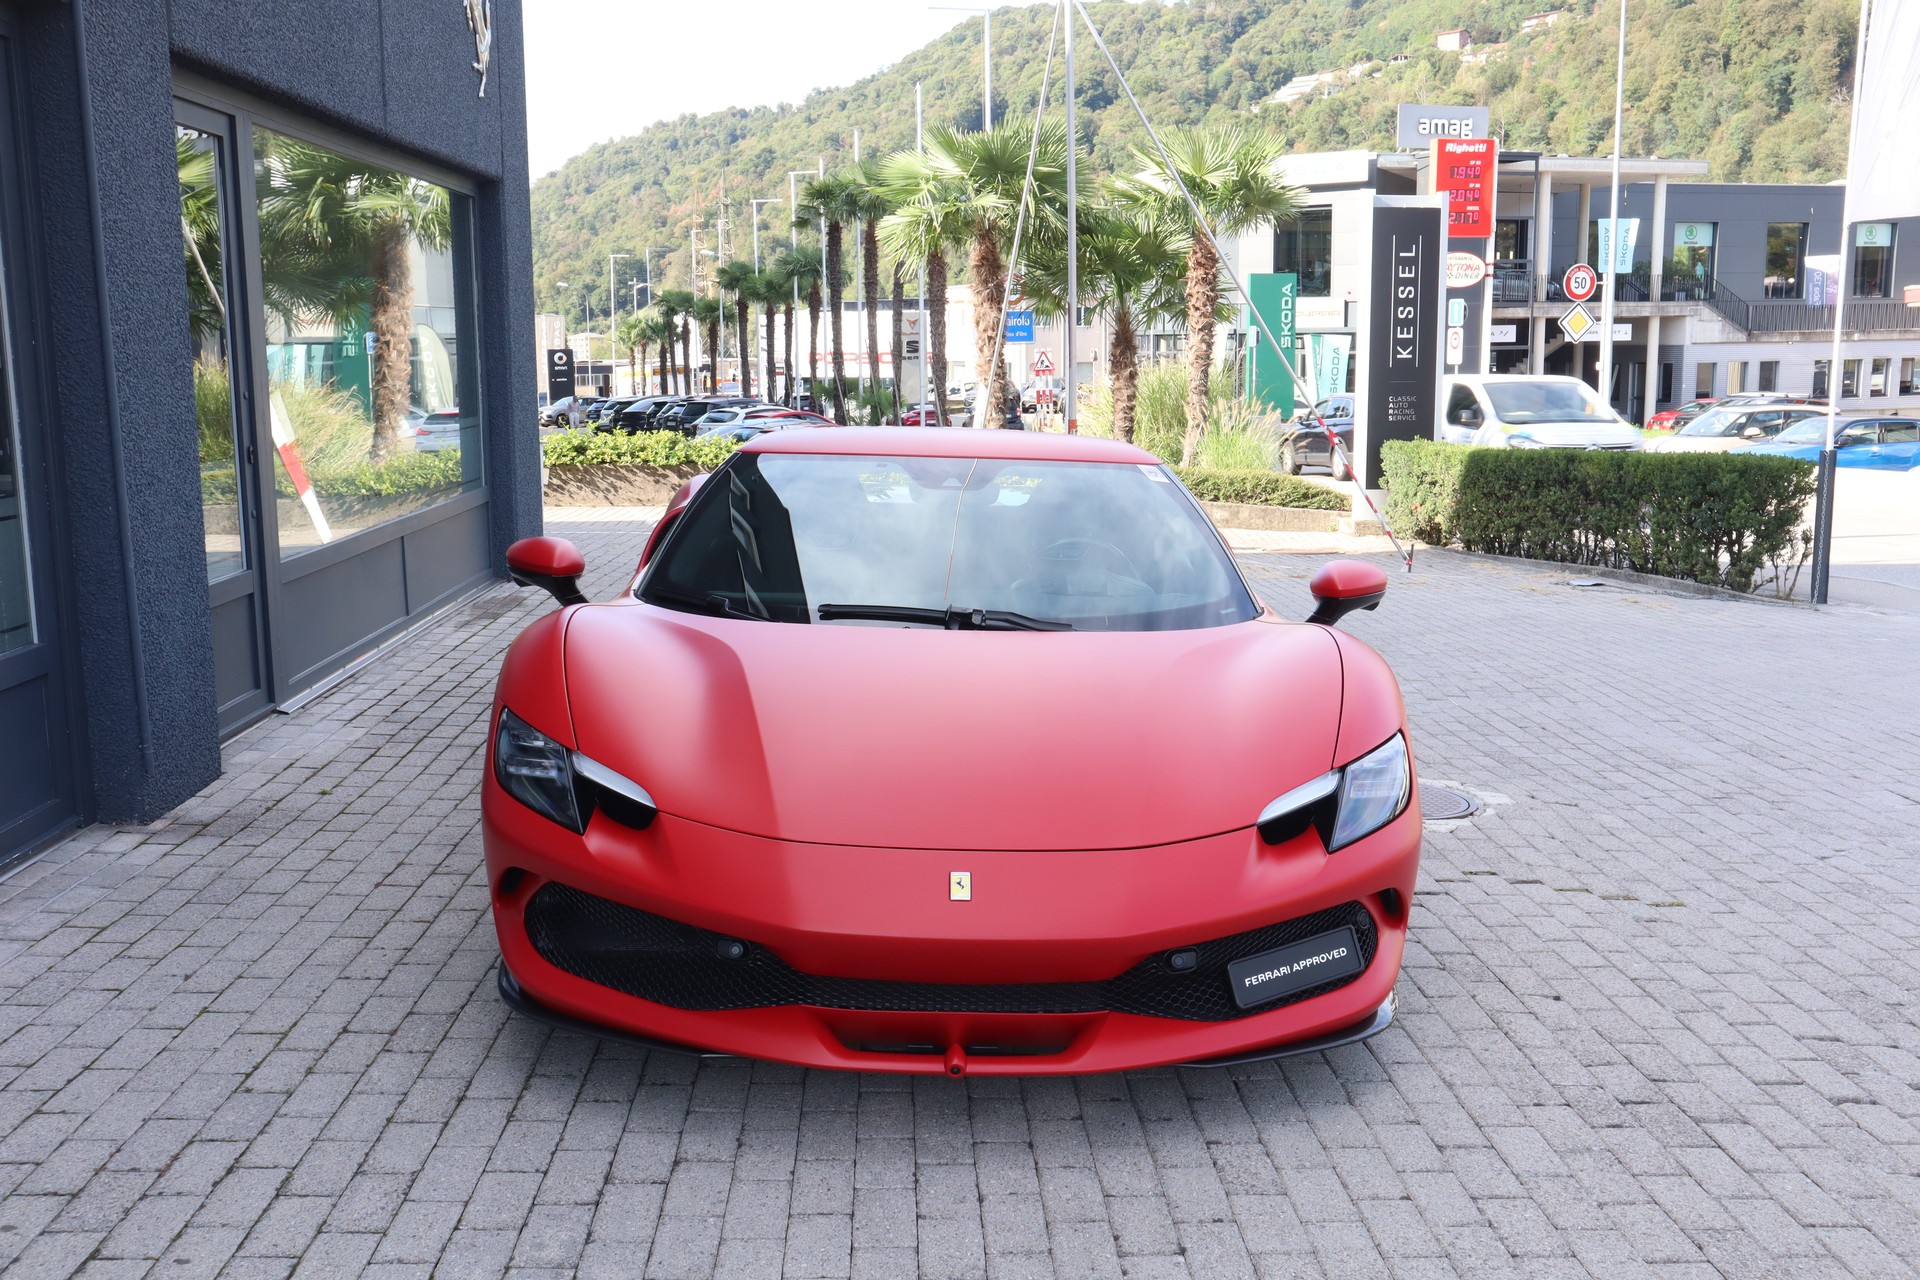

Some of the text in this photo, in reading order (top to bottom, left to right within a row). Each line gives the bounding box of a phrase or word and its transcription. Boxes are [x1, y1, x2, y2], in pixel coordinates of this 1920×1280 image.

[1418, 118, 1473, 139] amag
[1445, 143, 1487, 154] Righetti
[1446, 263, 1480, 272] AYTONA
[1574, 276, 1587, 290] 50
[1396, 244, 1416, 359] KESSEL
[1007, 315, 1031, 327] airolo
[1244, 947, 1348, 988] FERRARI APPROVED
